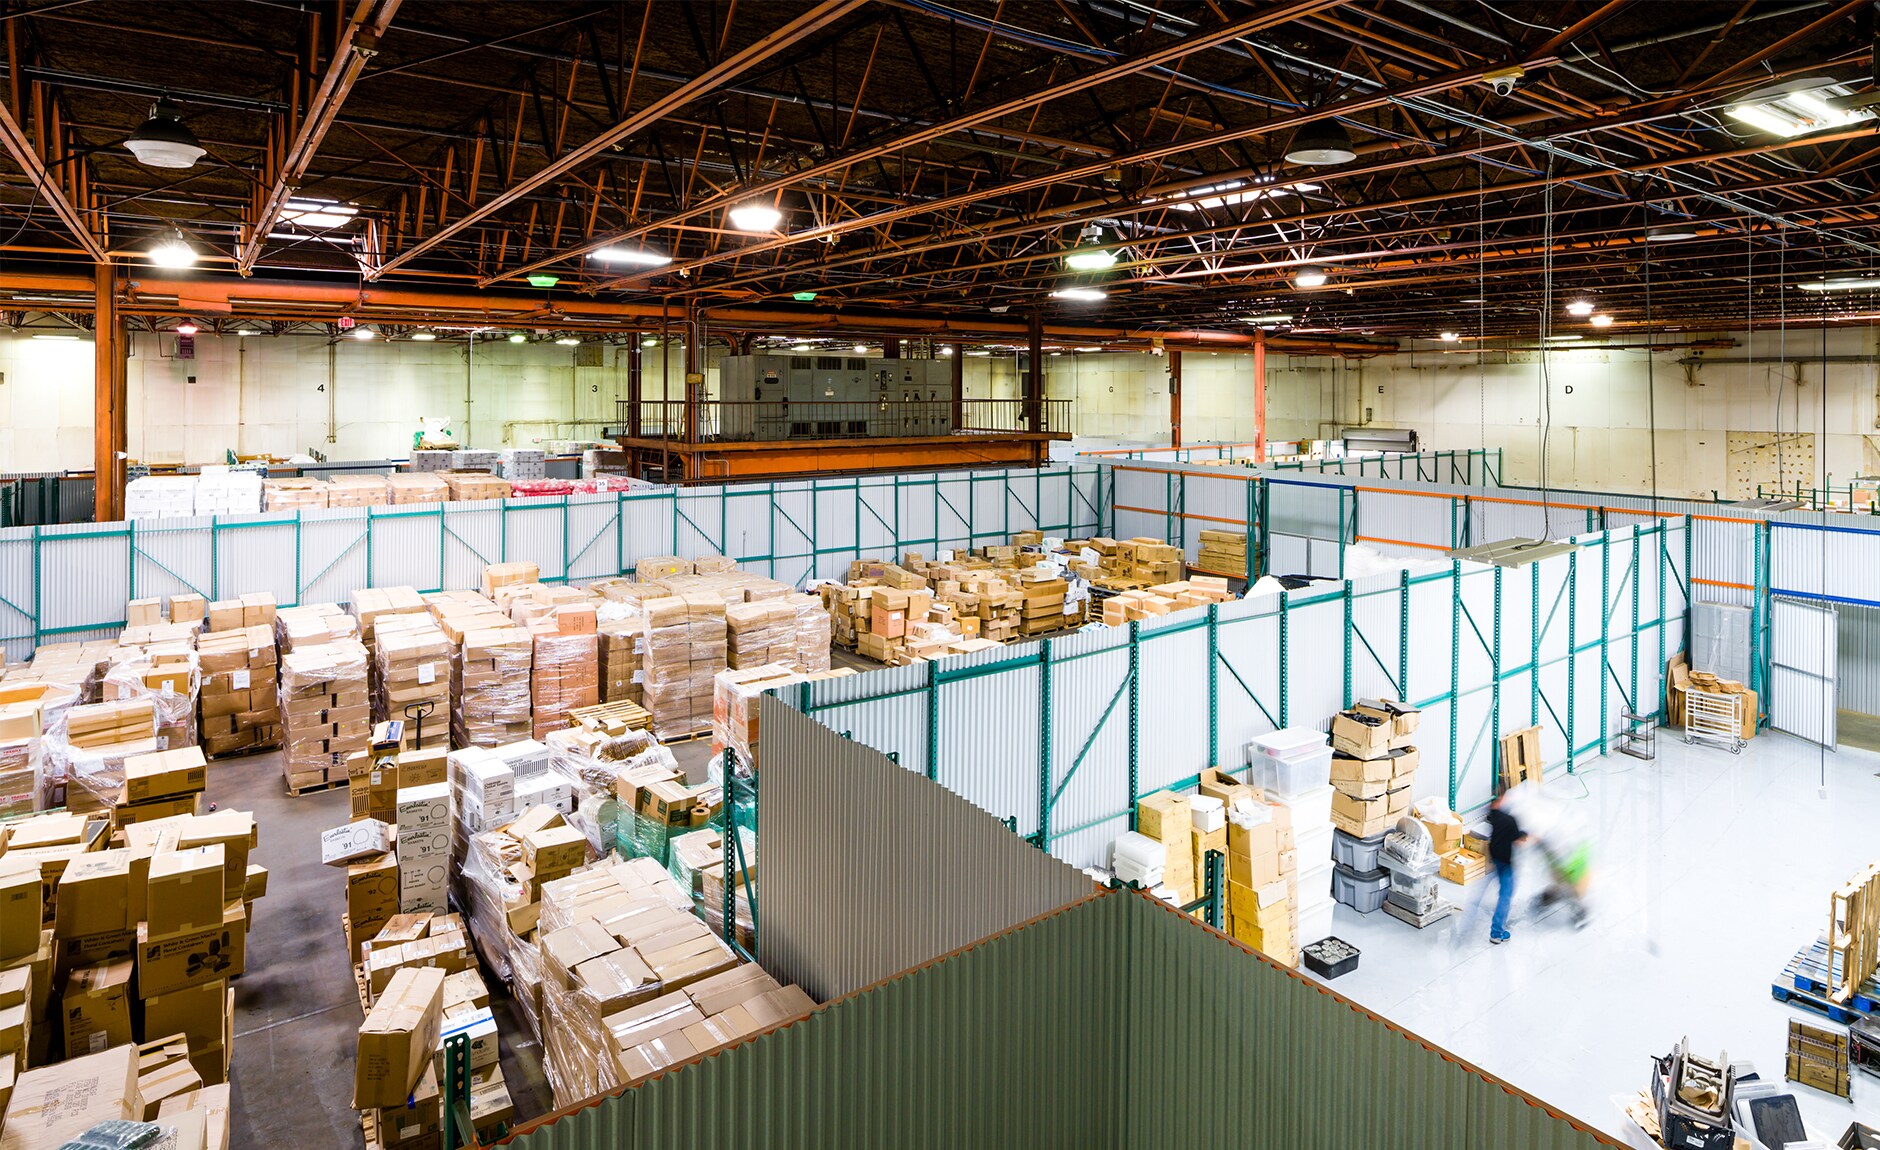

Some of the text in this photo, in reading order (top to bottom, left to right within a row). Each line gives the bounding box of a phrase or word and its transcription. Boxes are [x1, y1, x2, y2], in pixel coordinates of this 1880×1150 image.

[341, 318, 353, 327] EXIT
[317, 384, 325, 393] 4
[592, 384, 598, 393] 3
[1378, 385, 1384, 394] E
[1565, 385, 1573, 394] D
[419, 815, 429, 823] '91
[342, 842, 353, 850] '91
[420, 845, 431, 853] '91
